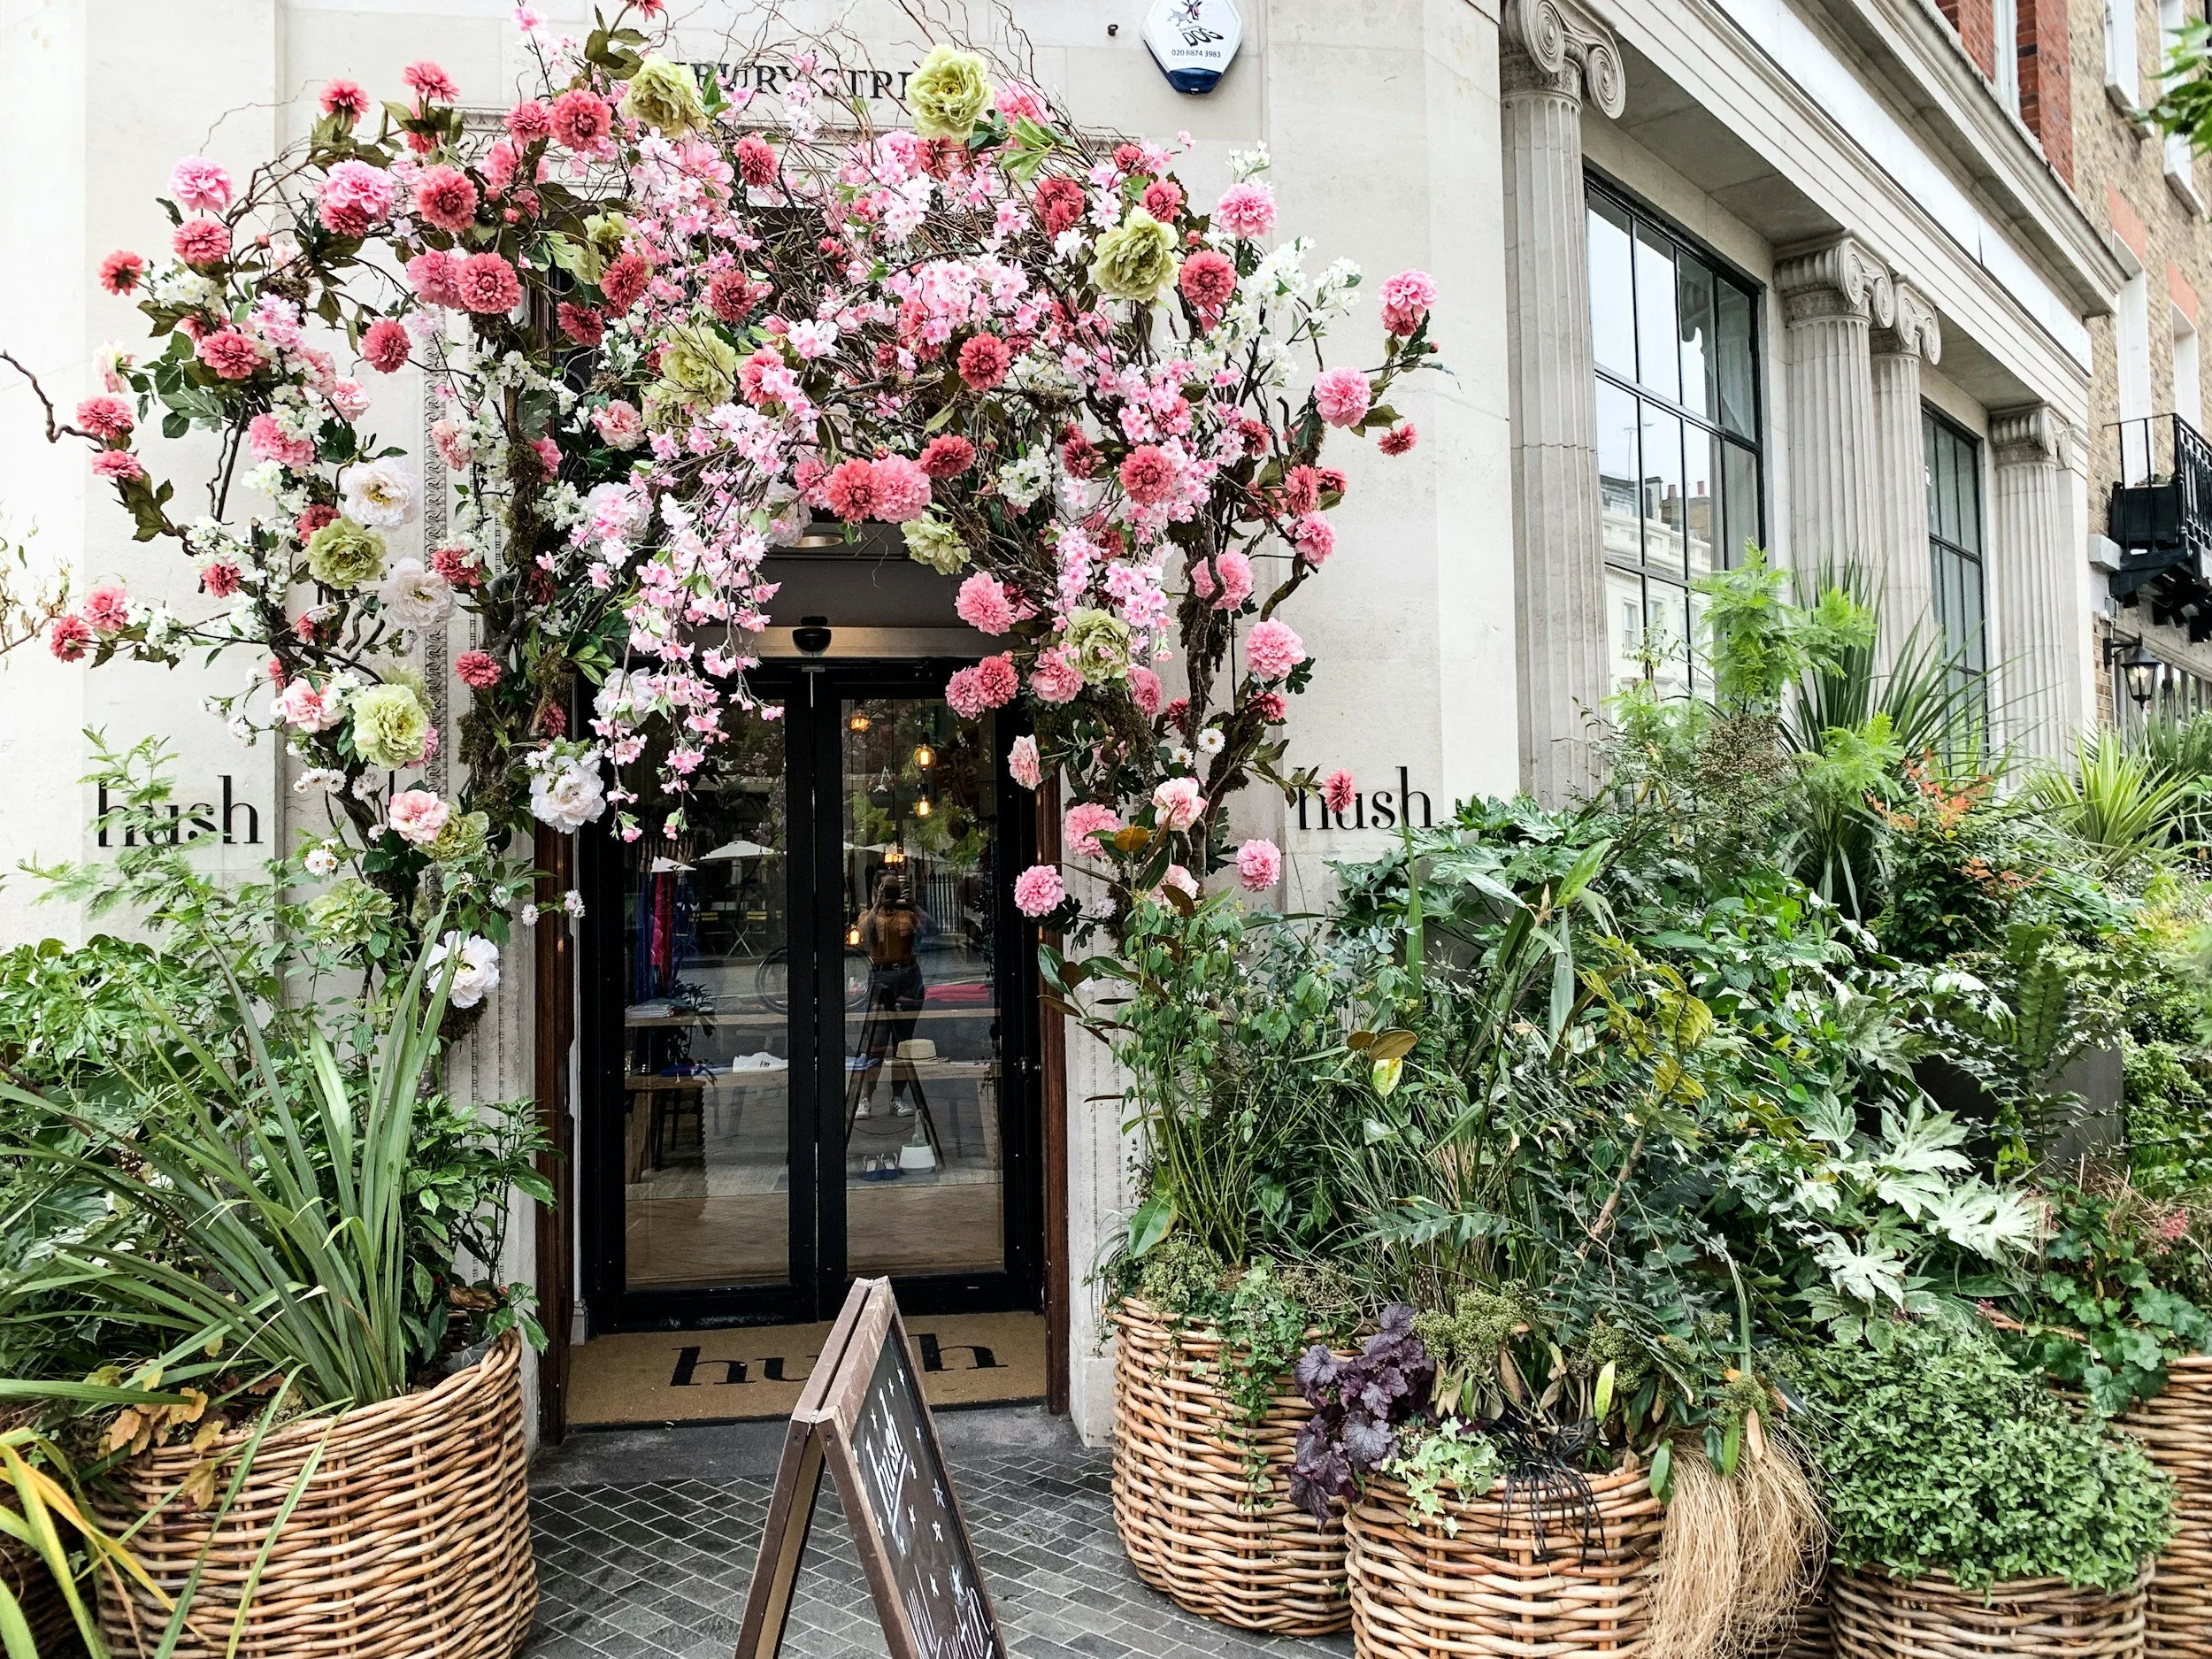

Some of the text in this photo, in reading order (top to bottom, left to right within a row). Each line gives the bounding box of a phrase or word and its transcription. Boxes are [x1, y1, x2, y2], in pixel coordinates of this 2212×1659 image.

[98, 775, 264, 847] hush
[1294, 766, 1435, 830] hush
[670, 1333, 1009, 1386] huh
[866, 1388, 903, 1525] hush
